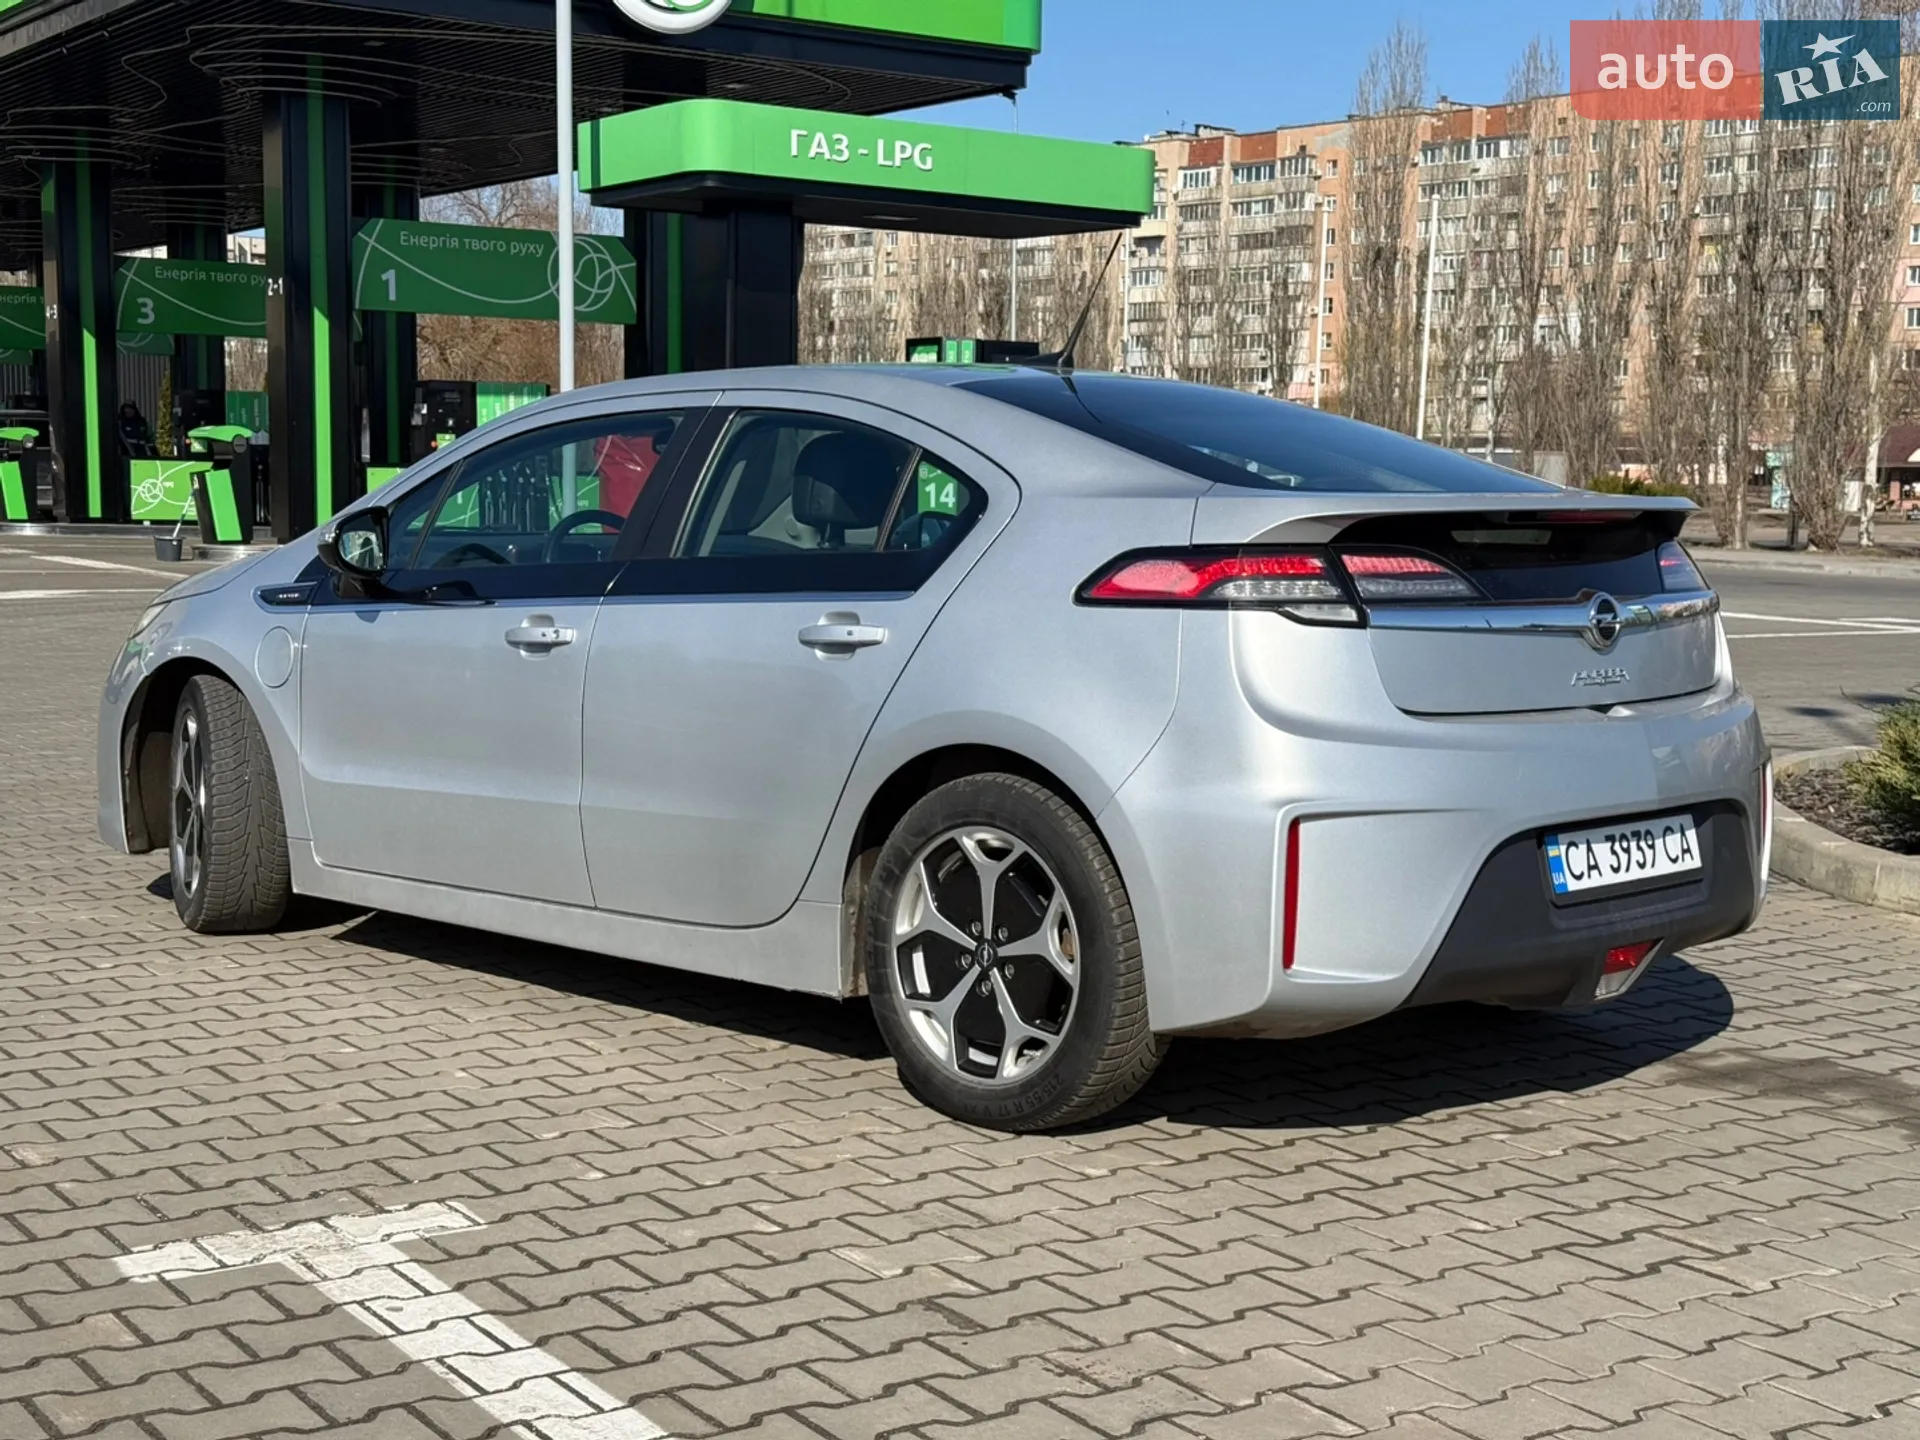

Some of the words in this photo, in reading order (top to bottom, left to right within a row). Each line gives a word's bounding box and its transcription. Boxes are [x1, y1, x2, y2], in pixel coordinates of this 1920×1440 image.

[790, 128, 851, 163] ГАЗ
[877, 138, 934, 171] LPG
[399, 230, 459, 250] Енергія
[463, 238, 507, 253] твого
[510, 241, 545, 257] руху
[154, 265, 207, 284] Енергія
[210, 272, 248, 285] твого
[250, 274, 266, 287] ру
[267, 277, 284, 296] 2-1
[380, 268, 397, 302] 1
[0, 292, 37, 306] нергія
[136, 296, 156, 325] 3
[924, 482, 956, 508] 14
[1564, 838, 1603, 881] CA
[1604, 825, 1657, 875] 3939
[1661, 822, 1695, 865] CA
[1552, 872, 1567, 885] UA
